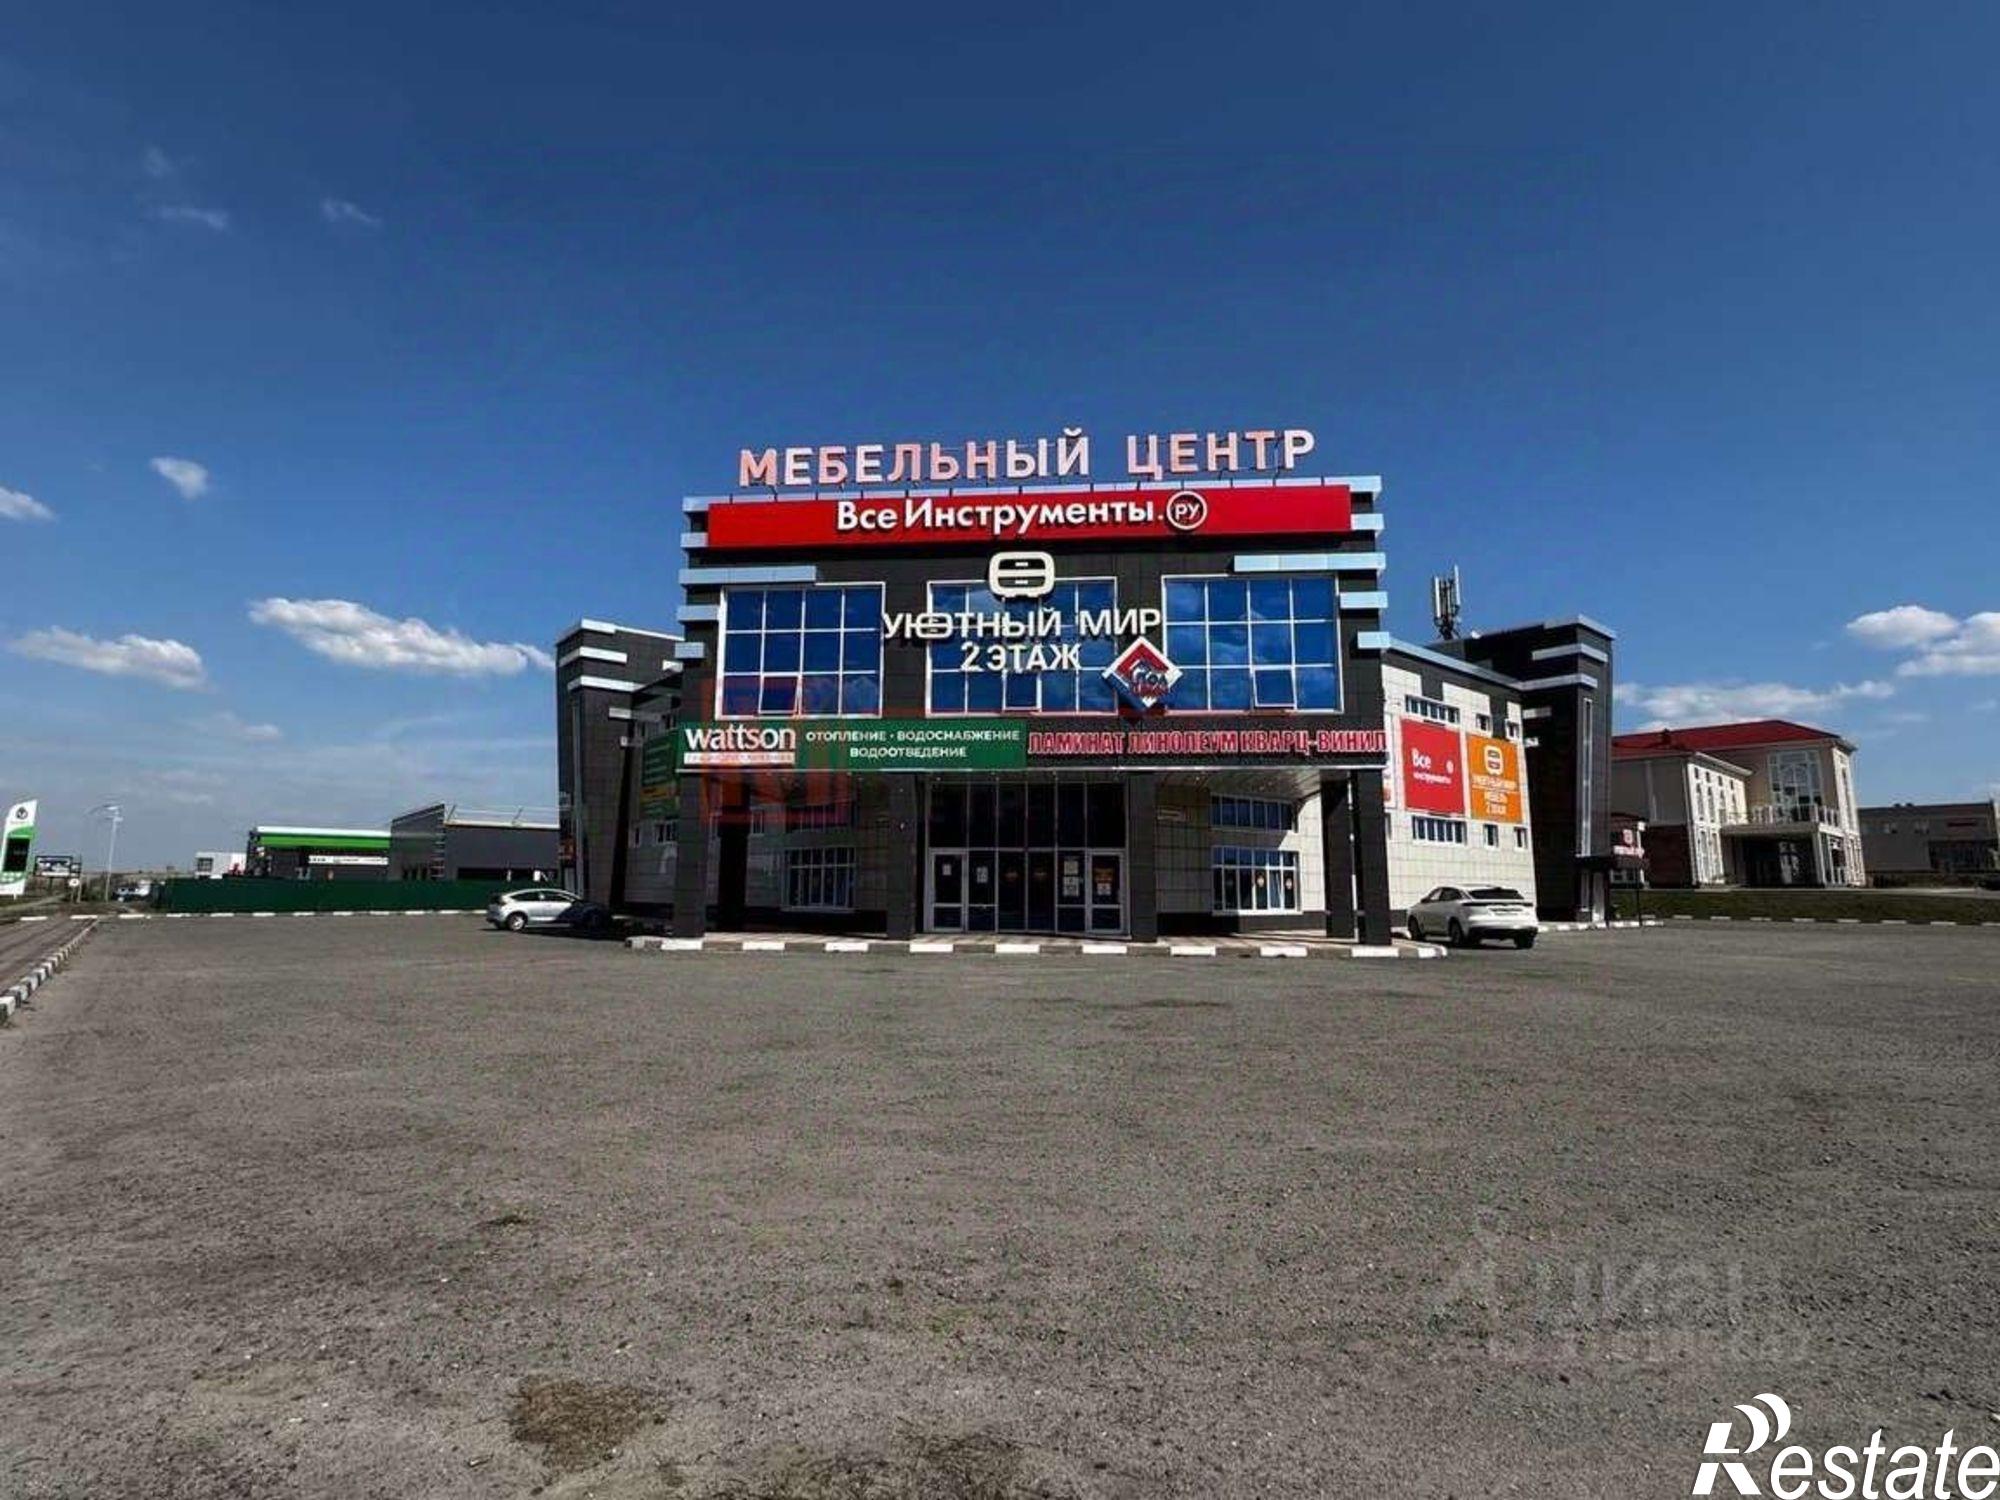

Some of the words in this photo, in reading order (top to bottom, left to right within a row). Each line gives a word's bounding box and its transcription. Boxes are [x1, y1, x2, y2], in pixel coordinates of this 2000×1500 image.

[739, 427, 1090, 487] МЕБЕЛЬНЫЙ
[1126, 429, 1315, 481] ЦЕНТР
[882, 606, 1062, 639] УЮТНЫЙ
[1079, 608, 1162, 638] МИР
[960, 641, 984, 672] 2
[987, 641, 1082, 673] ЭТАЖ
[684, 723, 796, 750] wattson
[806, 730, 886, 742] ОТОПЛЕНИЕ
[896, 730, 1020, 743] ВОДОСНАБЖЕНИЕ
[1027, 731, 1126, 754] ЛАМИНАТ
[1127, 731, 1240, 754] ЛИНОЛЕУМ
[1240, 730, 1388, 756] КВАРЦ-ВИНИЛ
[849, 746, 967, 759] ВОДООТВЕДЕНИЕ
